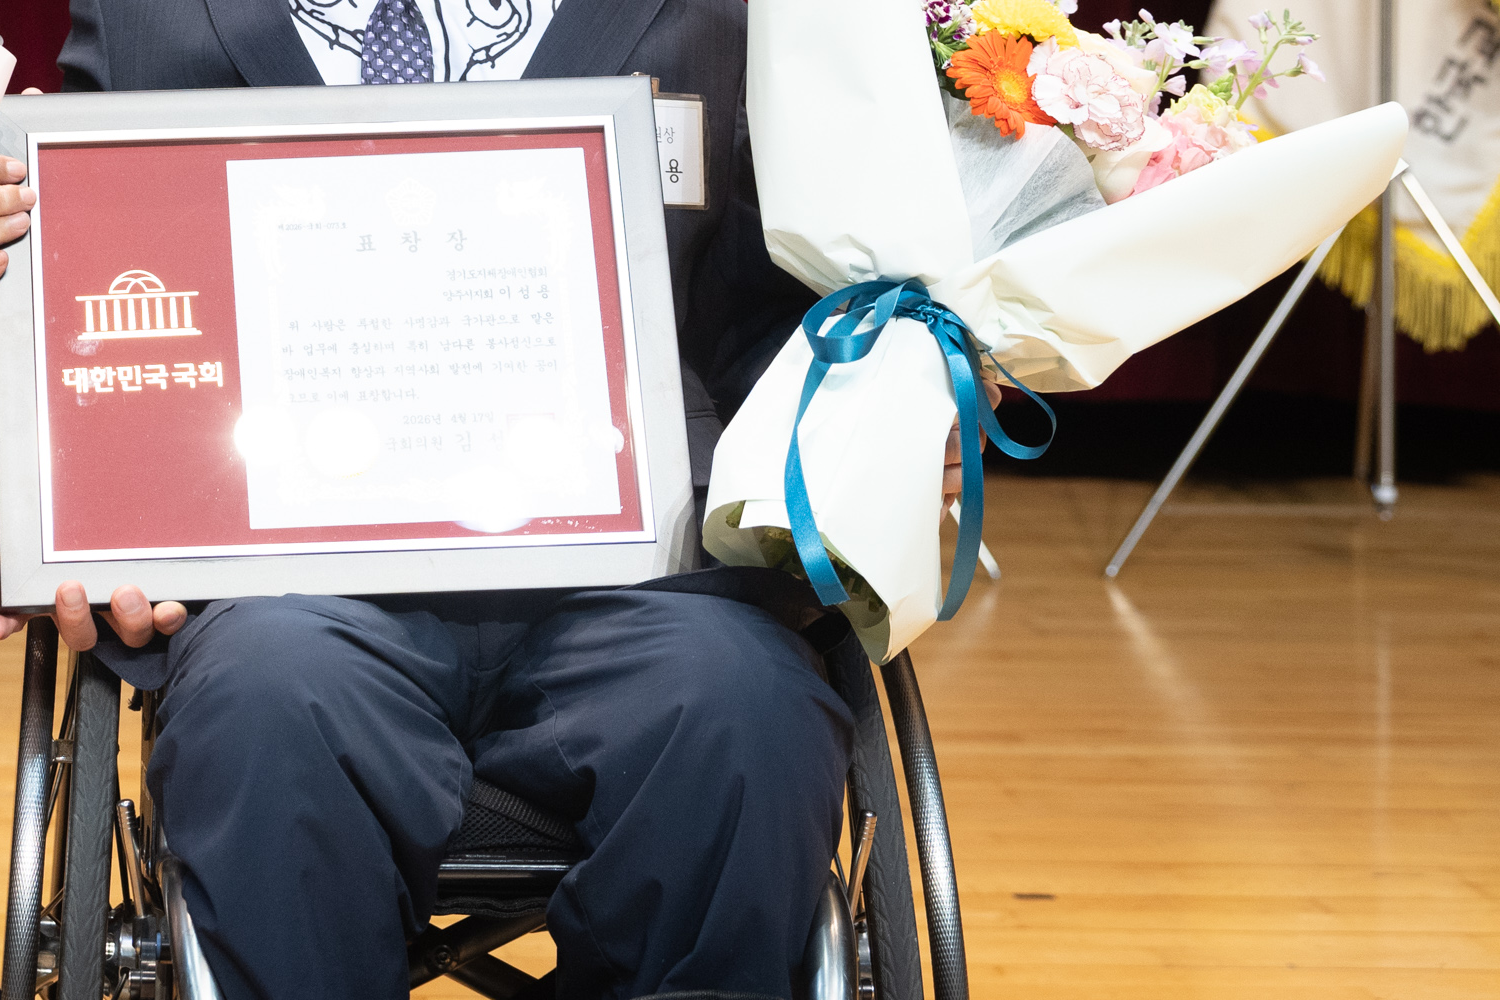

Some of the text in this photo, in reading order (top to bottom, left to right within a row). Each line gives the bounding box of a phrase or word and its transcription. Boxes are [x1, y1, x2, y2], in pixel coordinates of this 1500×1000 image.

[665, 158, 683, 183] 용
[446, 266, 548, 281] 경기도지체장애인협회
[443, 288, 493, 302] 양주시지회
[288, 319, 299, 332] 위
[311, 319, 346, 332] 사람은
[403, 315, 451, 329] 사명감과
[461, 313, 521, 327] 국가관으로
[282, 336, 557, 356] 바 업무에 충실하며 특히 남다른 봉사정신으로
[351, 365, 386, 379] 향상과
[394, 363, 440, 377] 지역사회
[449, 361, 483, 375] 발전에
[492, 359, 528, 373] 기여한
[535, 359, 557, 372] 공이
[327, 390, 350, 403] 이에
[357, 388, 420, 403] 표창합니다.
[403, 413, 442, 425] 2026년
[450, 412, 467, 424] 4월
[384, 435, 443, 453] 국회의원
